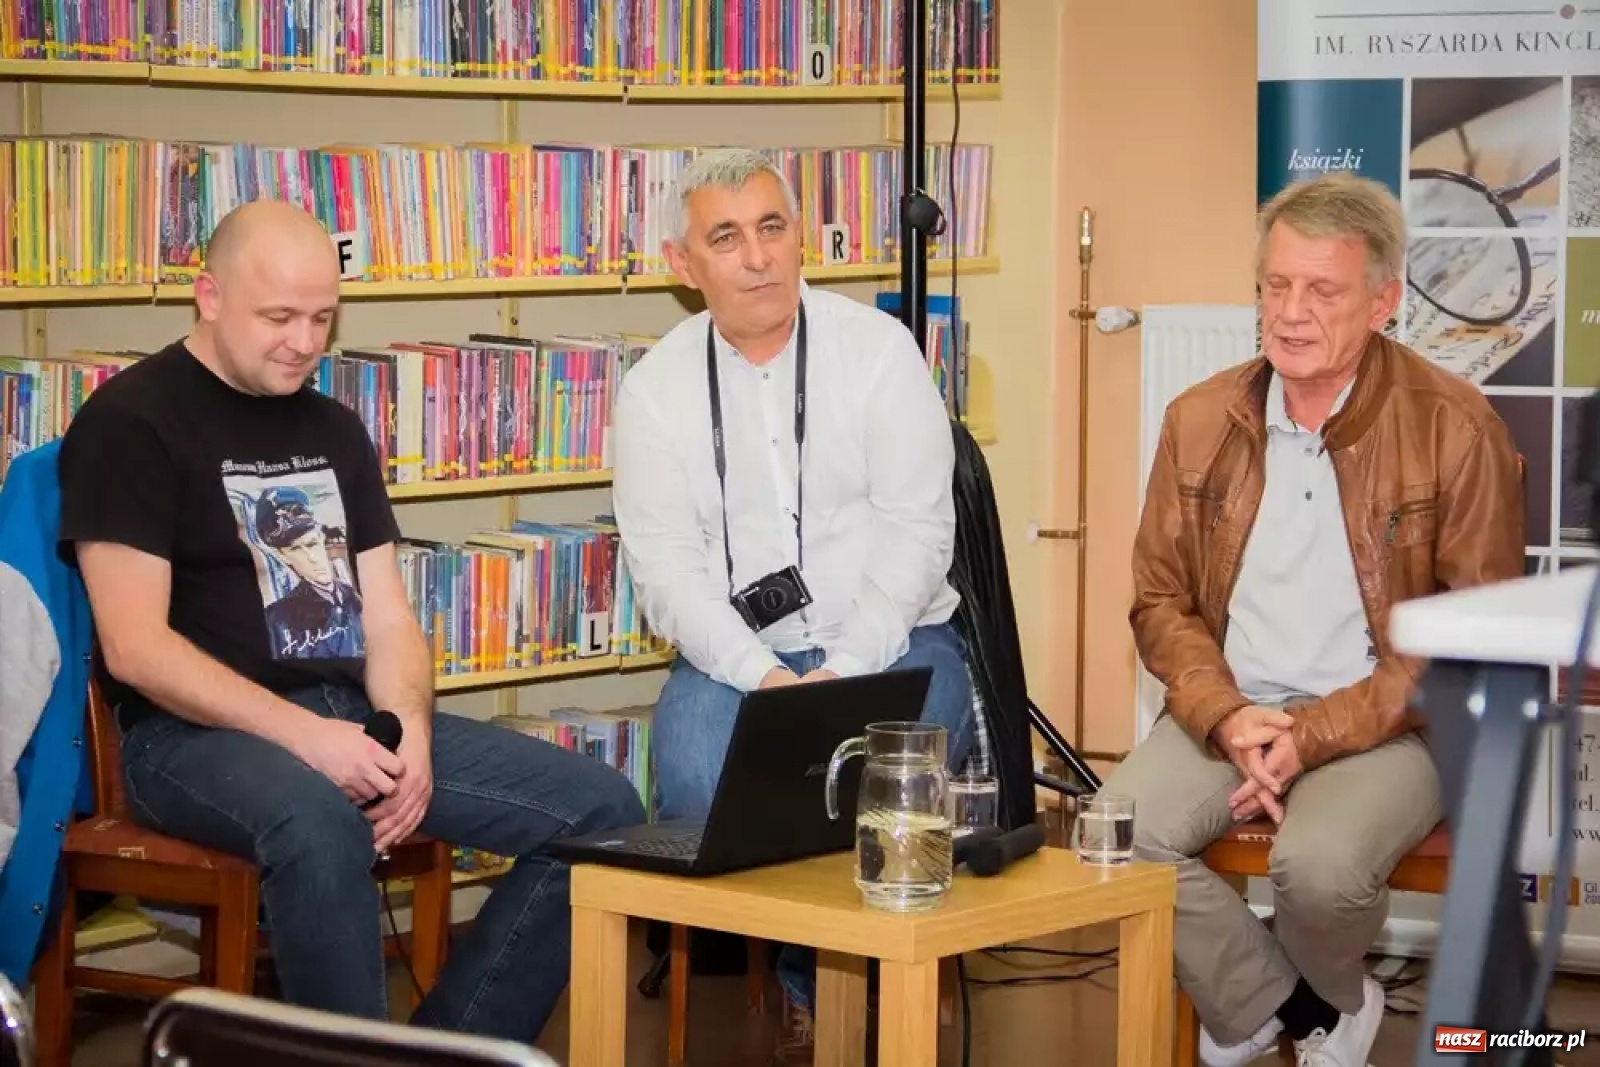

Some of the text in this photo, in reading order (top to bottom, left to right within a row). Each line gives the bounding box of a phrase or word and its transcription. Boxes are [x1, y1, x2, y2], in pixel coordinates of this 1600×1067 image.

[1314, 35, 1354, 55] IM.
[1368, 31, 1503, 54] RYSZARDA
[1288, 147, 1364, 174] książki
[337, 239, 353, 274] F
[831, 230, 845, 260] R
[589, 619, 602, 650] L
